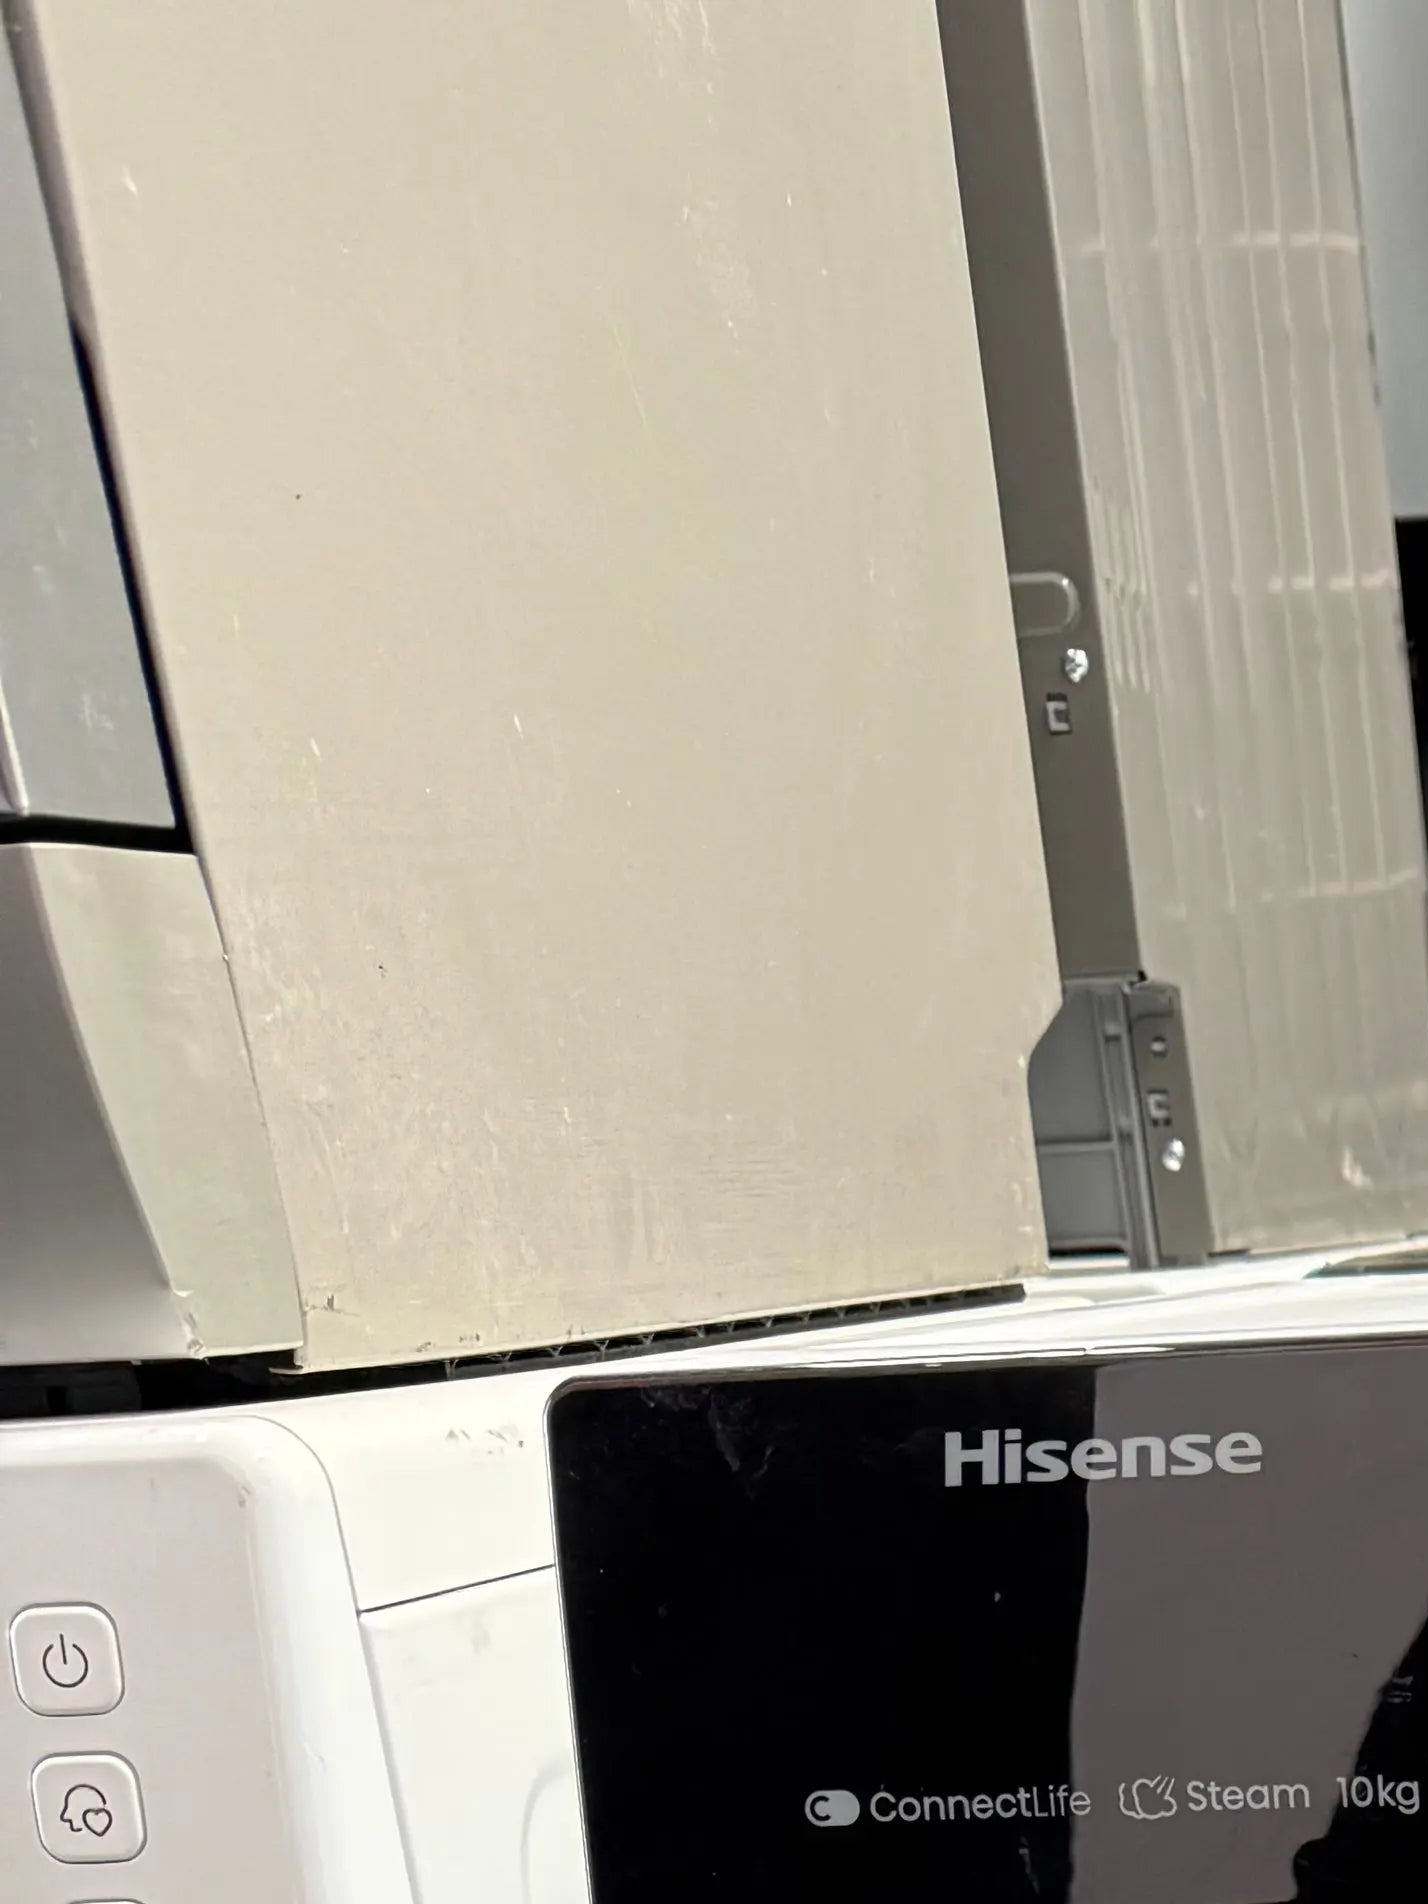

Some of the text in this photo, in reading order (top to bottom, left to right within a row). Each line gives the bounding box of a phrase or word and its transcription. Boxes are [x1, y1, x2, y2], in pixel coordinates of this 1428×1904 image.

[944, 1428, 1264, 1486] Hisense
[871, 1784, 1092, 1824] ConnectLife
[1187, 1773, 1421, 1815] Steam 10kg
